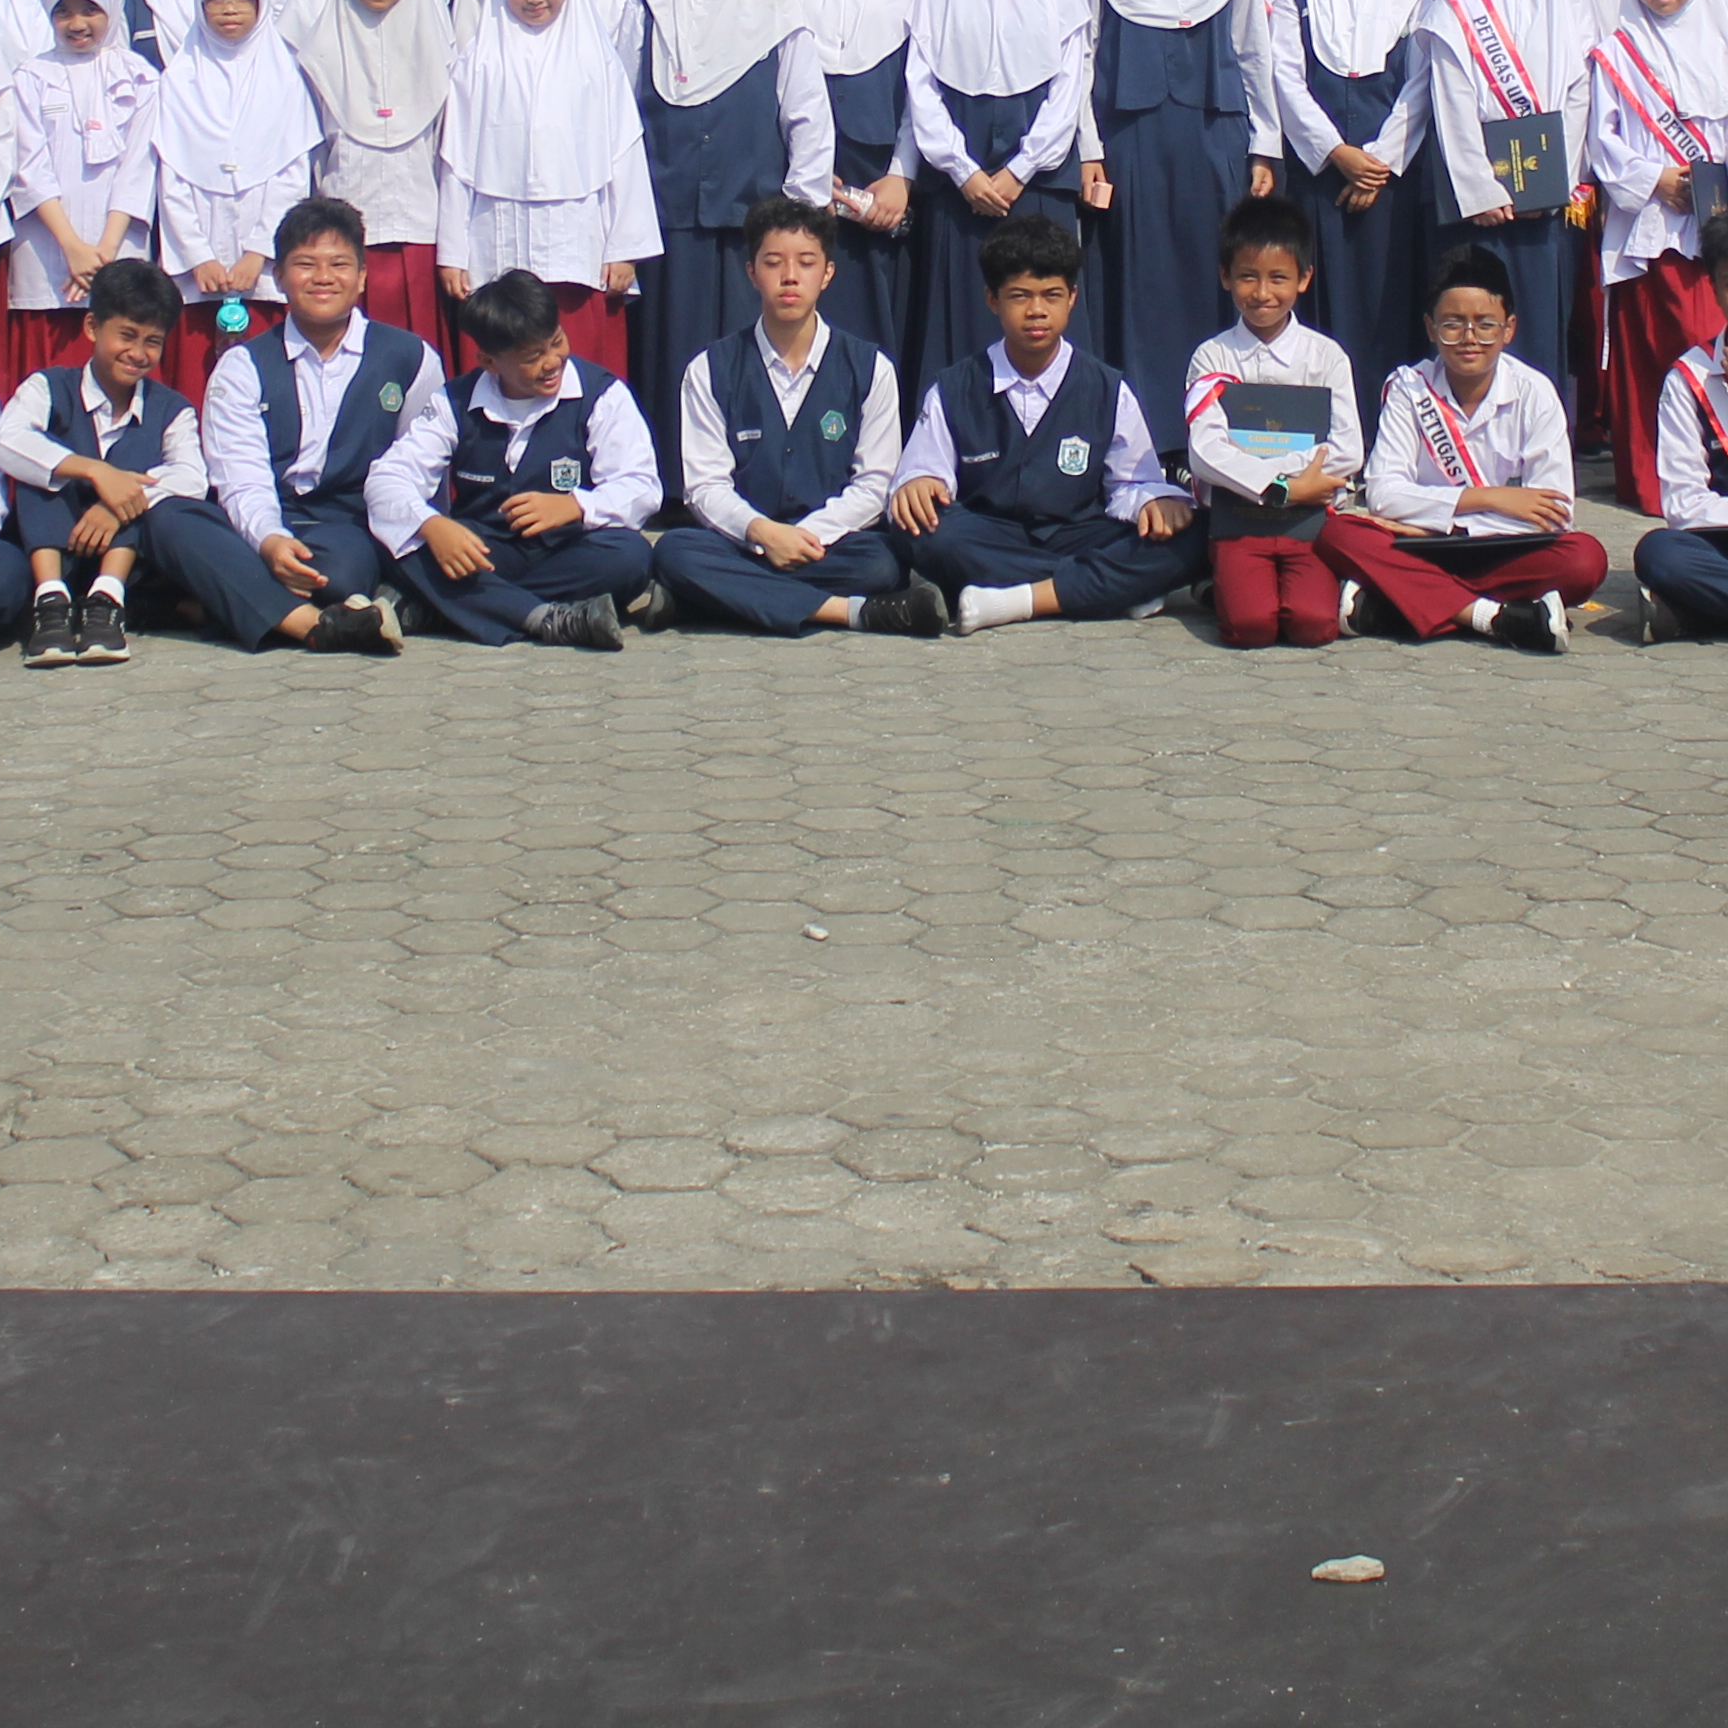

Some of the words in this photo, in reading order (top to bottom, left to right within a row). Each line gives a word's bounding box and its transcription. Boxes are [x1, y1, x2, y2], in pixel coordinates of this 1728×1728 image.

[1473, 14, 1516, 85] PETUGAS
[1657, 110, 1705, 162] PETUG
[1416, 396, 1462, 478] PETUGAS
